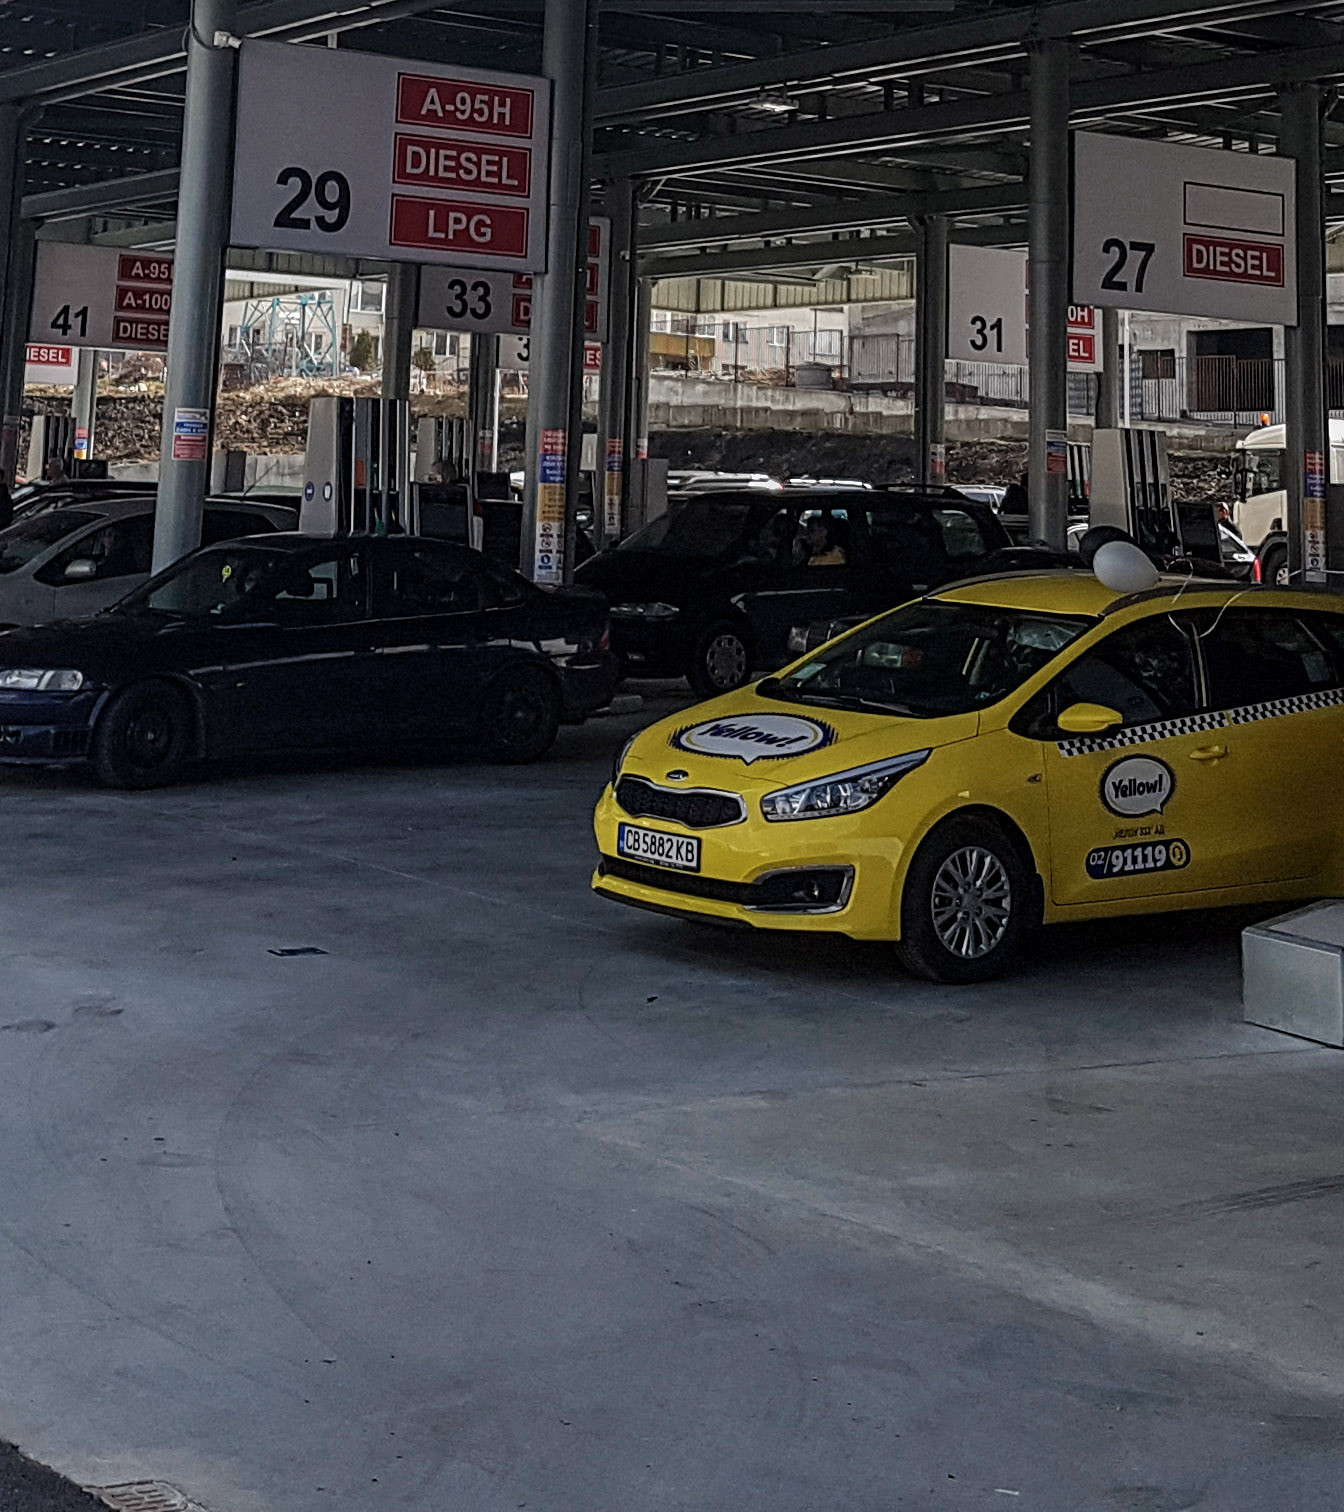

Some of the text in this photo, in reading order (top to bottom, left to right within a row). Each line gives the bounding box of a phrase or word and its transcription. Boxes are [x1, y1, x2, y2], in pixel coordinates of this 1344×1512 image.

[421, 89, 511, 127] A-95H
[406, 146, 519, 186] DIESEL
[274, 167, 351, 233] 29
[427, 210, 493, 242] LPG
[131, 261, 173, 279] A-95
[1102, 238, 1155, 293] 27
[1192, 245, 1275, 279] DIESEL
[447, 279, 491, 320] 33
[51, 305, 88, 337] 41
[119, 322, 168, 340] DIESE
[970, 316, 1002, 352] 31
[27, 348, 66, 362] IESEL
[698, 724, 809, 748] Yellow!
[1112, 774, 1163, 798] Yellow!
